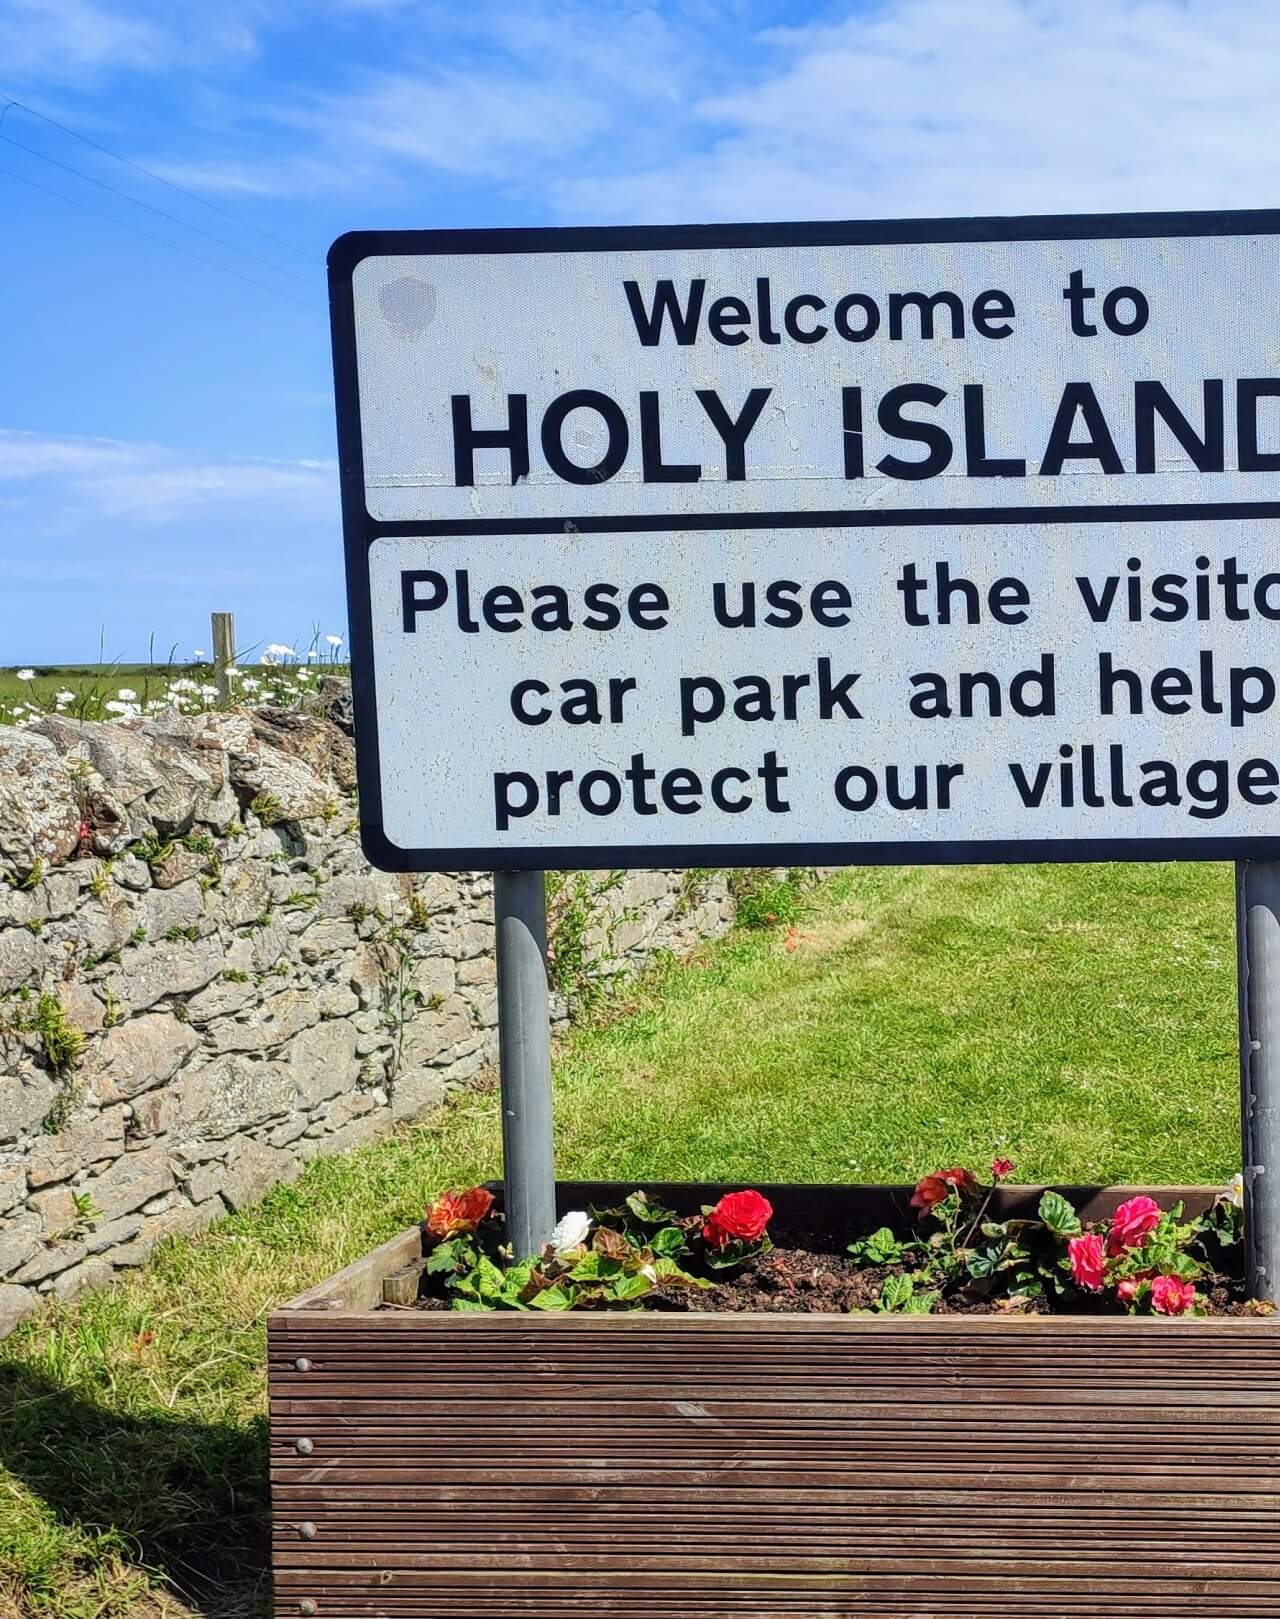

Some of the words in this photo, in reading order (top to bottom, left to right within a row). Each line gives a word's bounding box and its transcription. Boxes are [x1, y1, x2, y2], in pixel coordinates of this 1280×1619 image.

[622, 278, 1016, 347] Welcome
[1062, 269, 1150, 337] to
[450, 387, 773, 488] HOLY
[400, 569, 670, 634] Please
[712, 579, 853, 629] use
[896, 562, 1031, 627] the
[510, 677, 637, 726] car
[679, 656, 864, 737] park
[908, 652, 1056, 719] and
[1098, 650, 1276, 728] help
[493, 750, 791, 831] protect
[834, 763, 964, 812] our
